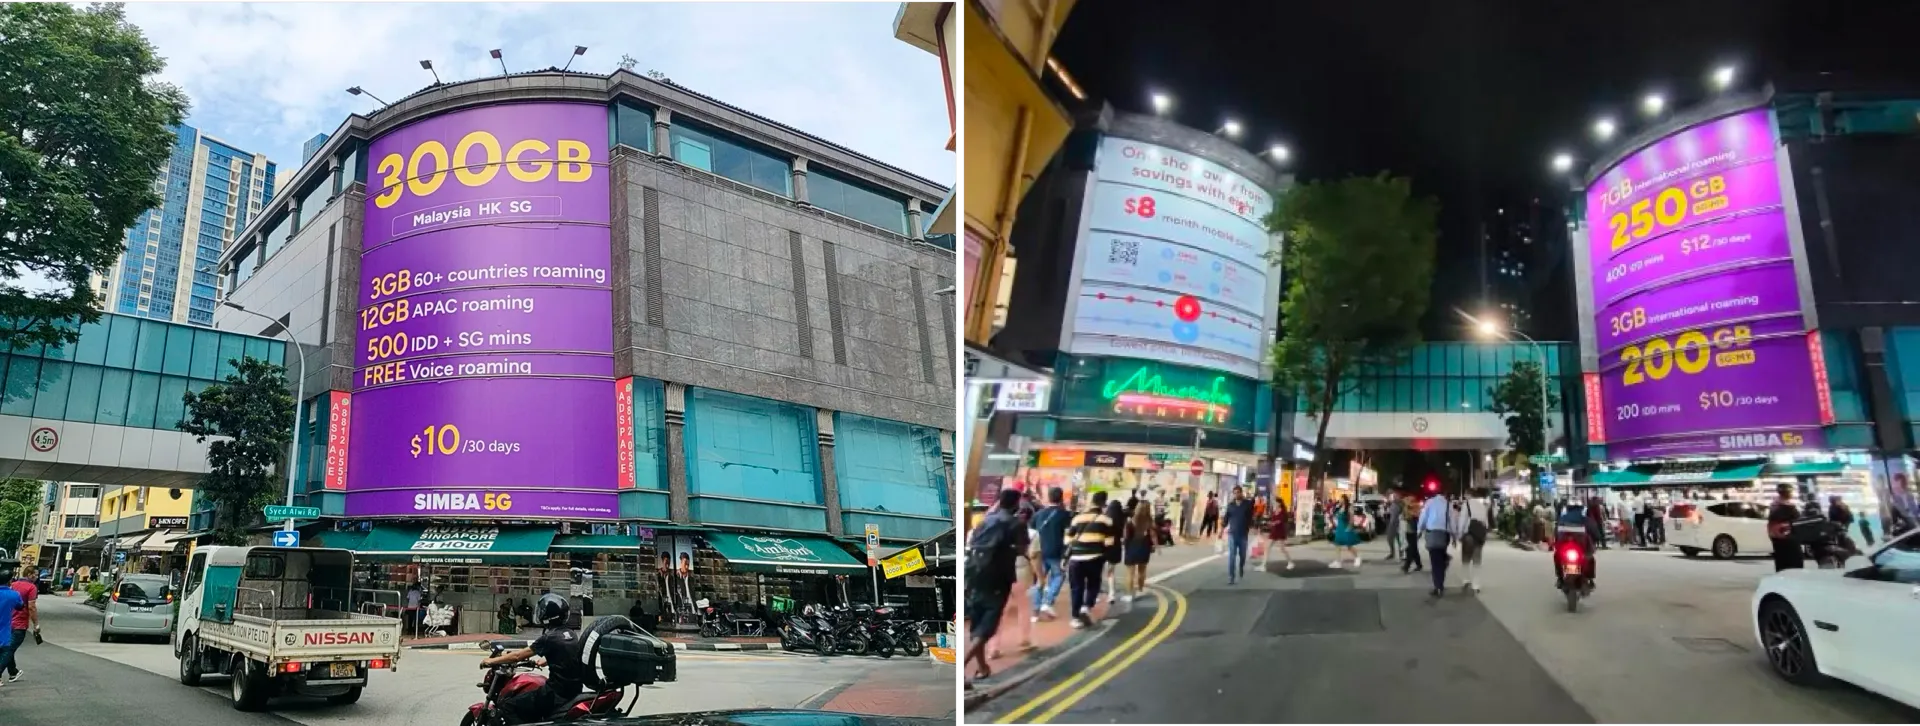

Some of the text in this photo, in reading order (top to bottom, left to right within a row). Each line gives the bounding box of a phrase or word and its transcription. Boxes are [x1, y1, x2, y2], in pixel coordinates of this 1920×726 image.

[374, 130, 593, 209] 300GB
[1132, 166, 1193, 189] savings
[1197, 183, 1226, 200] with
[1600, 150, 1736, 213] 7GB International roaming
[413, 200, 533, 227] Malaysia HK SG
[1124, 195, 1235, 242] $8 month mobile
[1609, 175, 1726, 252] 250 GB
[1681, 234, 1711, 256] $12
[370, 264, 606, 299] 3GB 60+ countries roaming
[1606, 263, 1627, 283] 400
[361, 295, 534, 331] 12GB APAC roaming
[1610, 294, 1759, 337] 3GB International roaming
[367, 332, 408, 361] 500
[411, 335, 438, 352] IDD
[458, 331, 484, 347] SG
[489, 329, 532, 346] mins
[1621, 324, 1752, 387] 200 GB
[363, 357, 532, 387] FREE Voice roaming
[1617, 403, 1639, 420] 200
[1658, 404, 1681, 414] mins
[1699, 390, 1733, 410] $10
[1754, 396, 1778, 405] days
[35, 435, 54, 445] 4.5m
[328, 403, 339, 476] ADSPACE
[340, 408, 348, 444] 8812
[410, 424, 520, 458] $10 /30 days
[618, 392, 626, 474] ADSPACE
[1719, 432, 1782, 449] SIMBA
[269, 506, 317, 516] Syed Alwi Rd
[414, 493, 512, 511] SIMBA 5G
[415, 540, 490, 550] 24 HOUR
[420, 532, 498, 541] SINGAPORE
[258, 630, 269, 644] LTD
[304, 632, 375, 646] NISSAN
